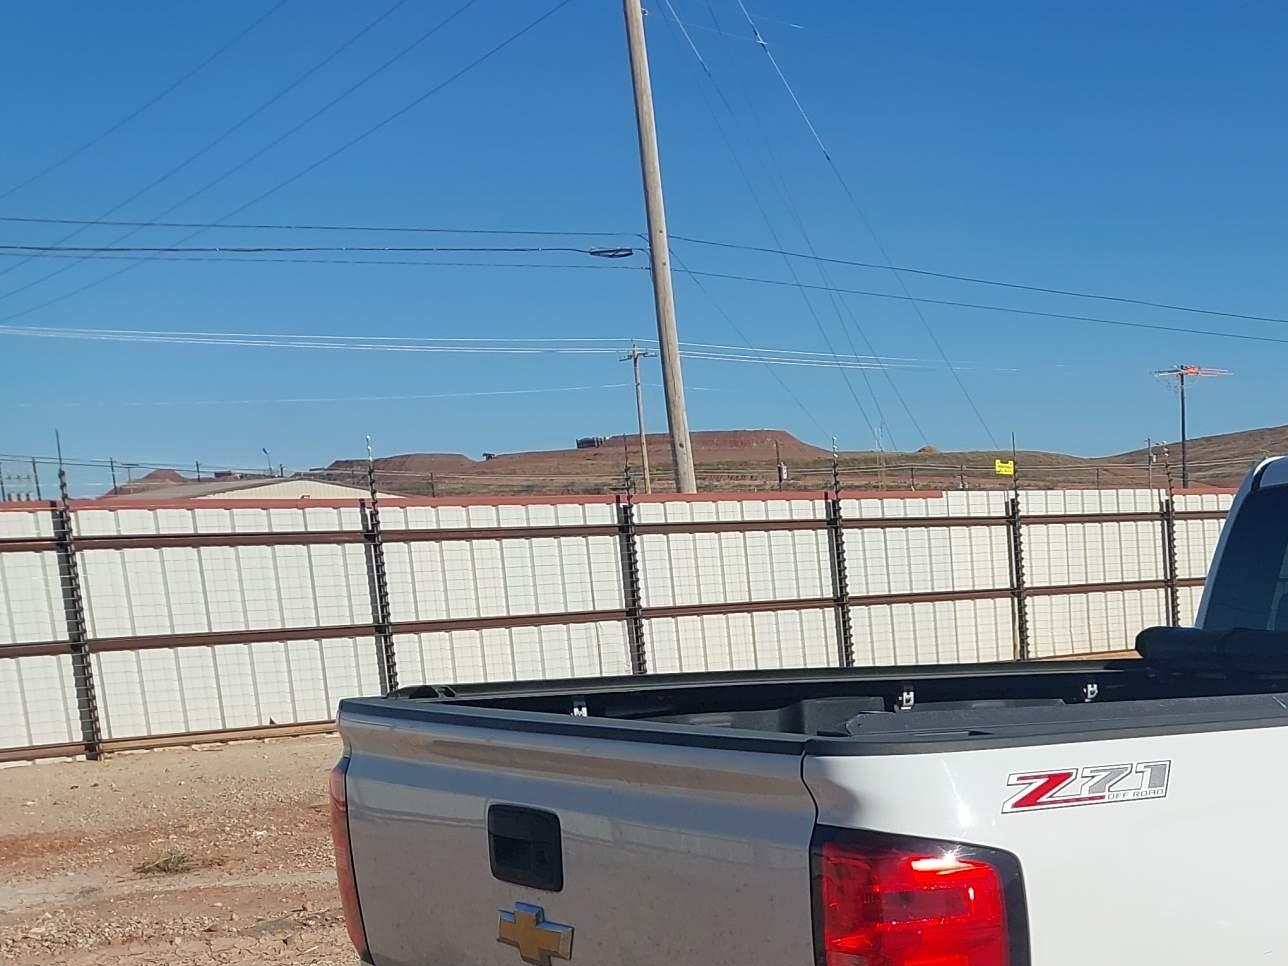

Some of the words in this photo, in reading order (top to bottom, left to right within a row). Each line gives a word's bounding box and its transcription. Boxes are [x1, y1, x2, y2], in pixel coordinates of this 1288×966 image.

[1001, 760, 1171, 814] Z71
[1107, 792, 1129, 800] OFF
[1132, 788, 1164, 798] ROAD
